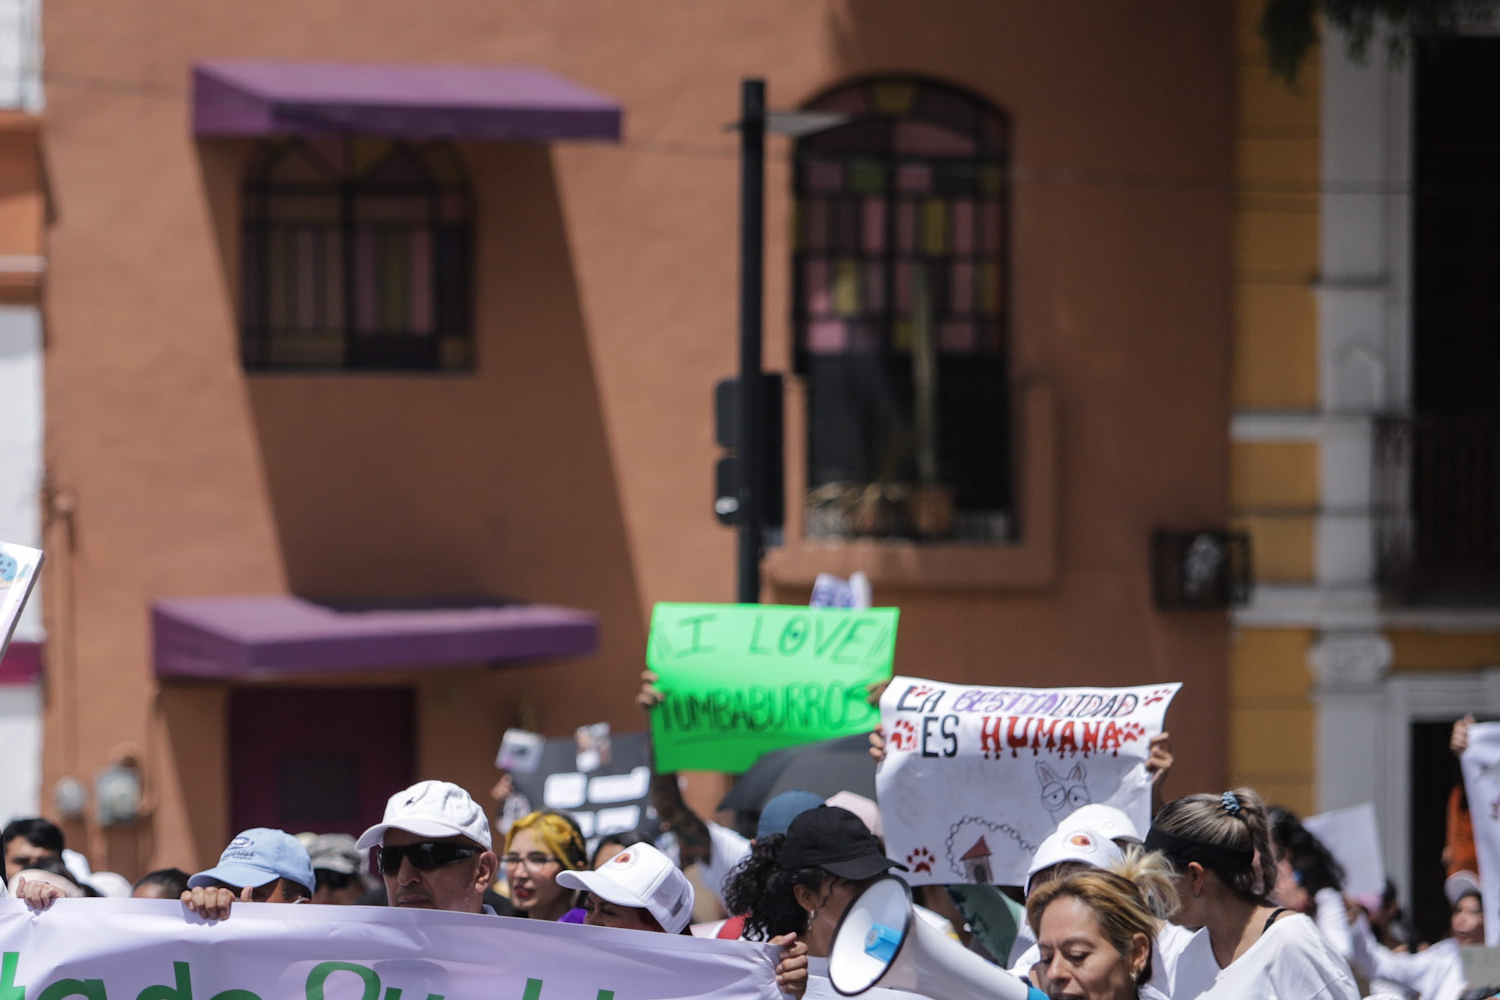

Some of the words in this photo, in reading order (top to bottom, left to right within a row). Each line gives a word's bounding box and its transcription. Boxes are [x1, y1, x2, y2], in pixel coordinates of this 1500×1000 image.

[675, 613, 719, 660] I
[749, 613, 879, 664] LOVE
[951, 689, 1139, 718] BESTIALIDAD
[921, 715, 960, 758] ES
[980, 715, 1123, 760] HUMANA
